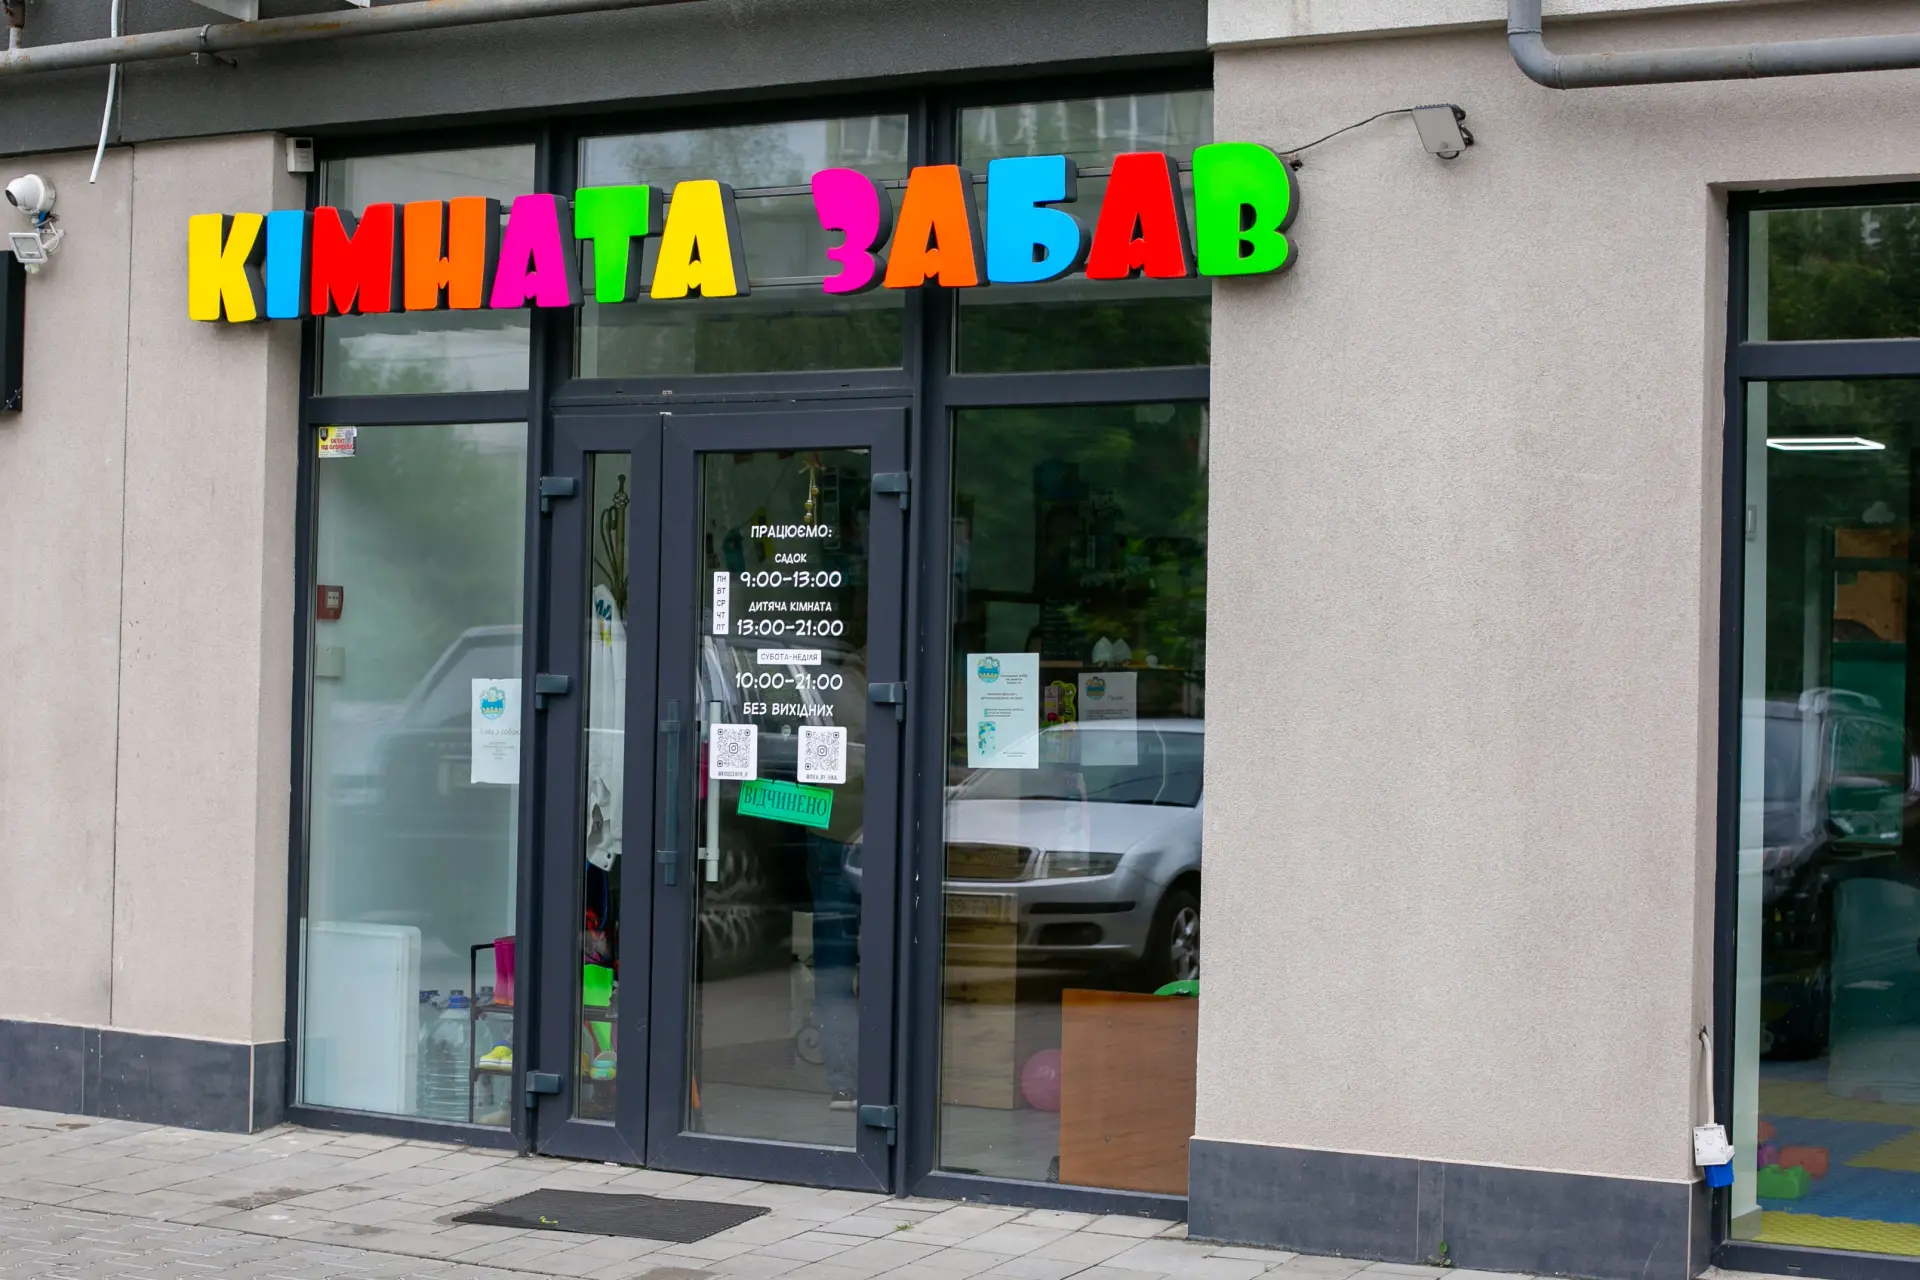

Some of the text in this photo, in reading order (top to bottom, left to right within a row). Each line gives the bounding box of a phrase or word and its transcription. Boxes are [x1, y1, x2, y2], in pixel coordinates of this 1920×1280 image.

[189, 142, 1297, 323] КІМНАТА ЗАБАВ
[750, 524, 833, 540] ПРАЦЮЄМО:
[774, 553, 808, 564] САДОК
[716, 575, 727, 583] ПН
[740, 571, 842, 588] 9:00-13:00
[716, 587, 726, 595] ВТ
[748, 601, 832, 613] ДИТЯЧА КІМНАТА
[715, 623, 725, 631] ПТ
[737, 619, 844, 637] 13:00-21:00
[760, 653, 818, 662] СУБОТА-НЕДІЛЯ
[735, 672, 843, 691] 10:00-21:00
[743, 702, 834, 718] БЕЗ ВИХІДНИХ
[743, 785, 828, 817] ВІДЧИНЕНО
